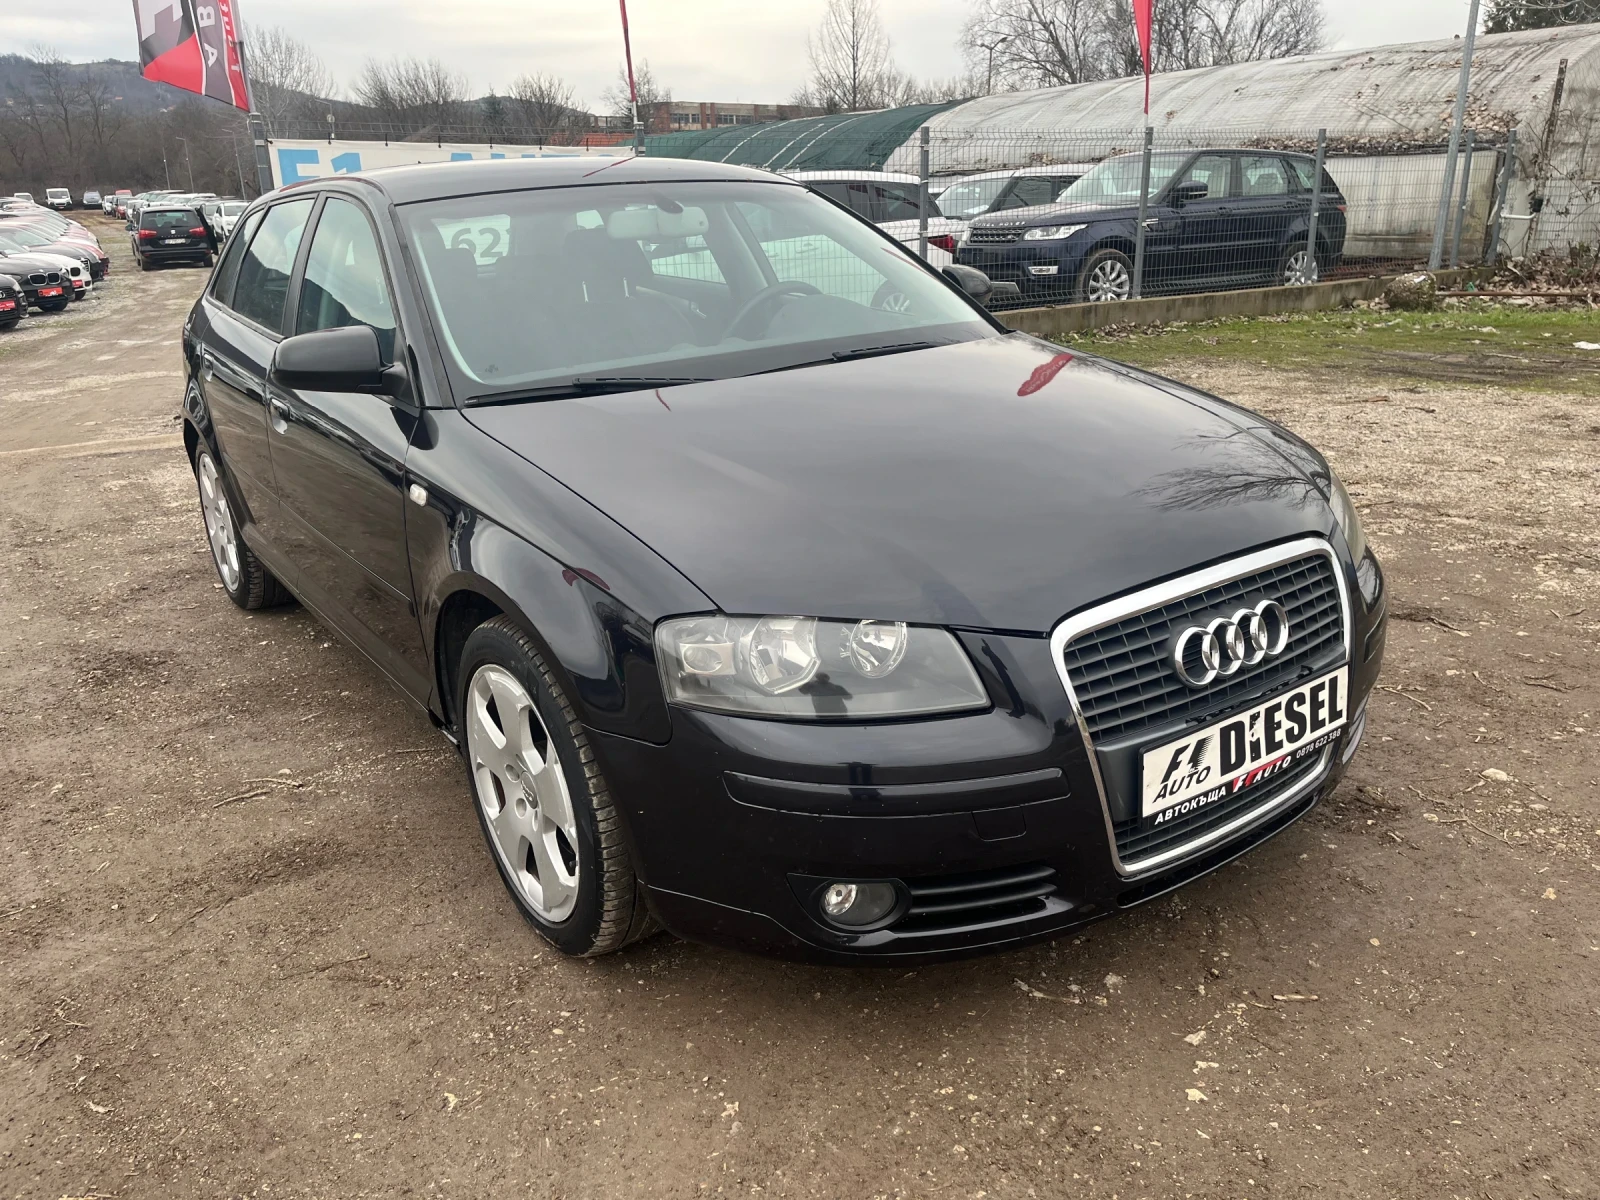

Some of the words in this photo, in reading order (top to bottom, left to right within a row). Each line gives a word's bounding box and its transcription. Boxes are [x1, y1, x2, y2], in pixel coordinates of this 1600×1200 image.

[450, 227, 510, 258] 62
[1219, 675, 1343, 777] DIESEL
[1253, 756, 1291, 783] AUTO
[1296, 743, 1315, 759] 0878
[1152, 765, 1211, 803] AUTO
[1154, 786, 1227, 825] АВТОКЪЩА
